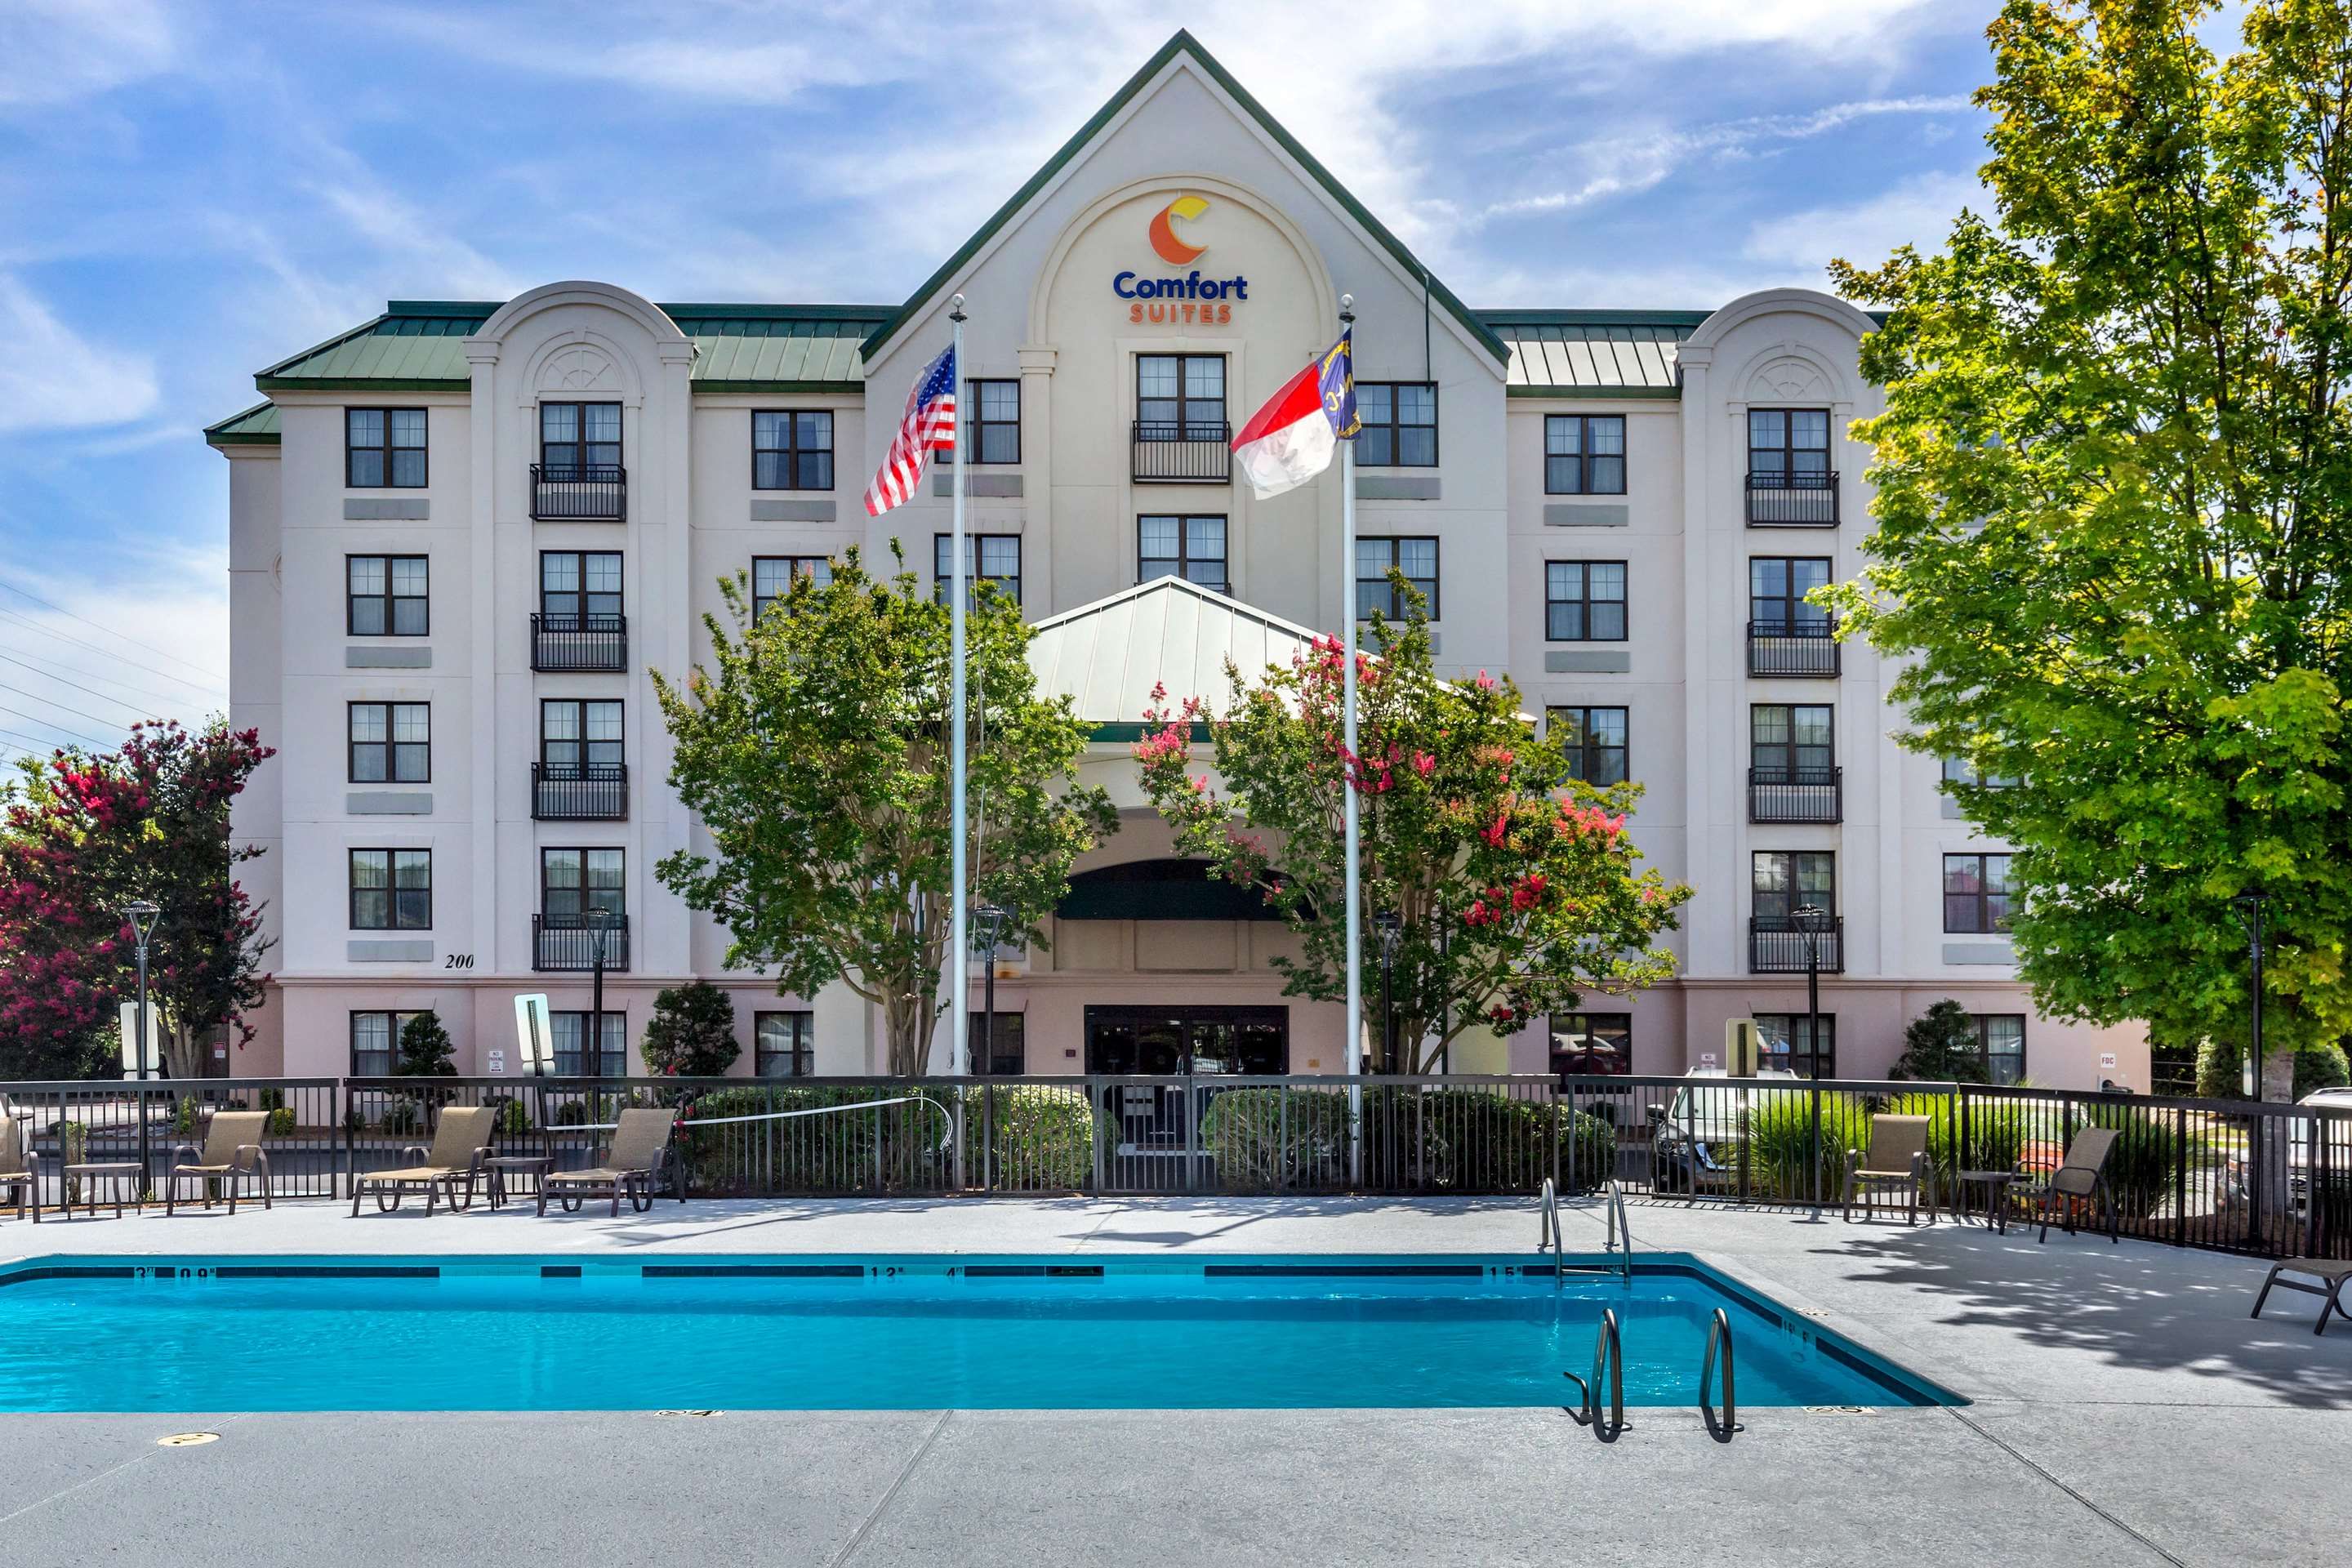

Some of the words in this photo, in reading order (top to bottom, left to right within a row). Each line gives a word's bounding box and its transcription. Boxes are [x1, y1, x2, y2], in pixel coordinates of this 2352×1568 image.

[1113, 271, 1248, 300] Comfort
[1129, 304, 1232, 323] SUITES
[444, 955, 474, 969] 200
[2101, 1057, 2114, 1065] FDC
